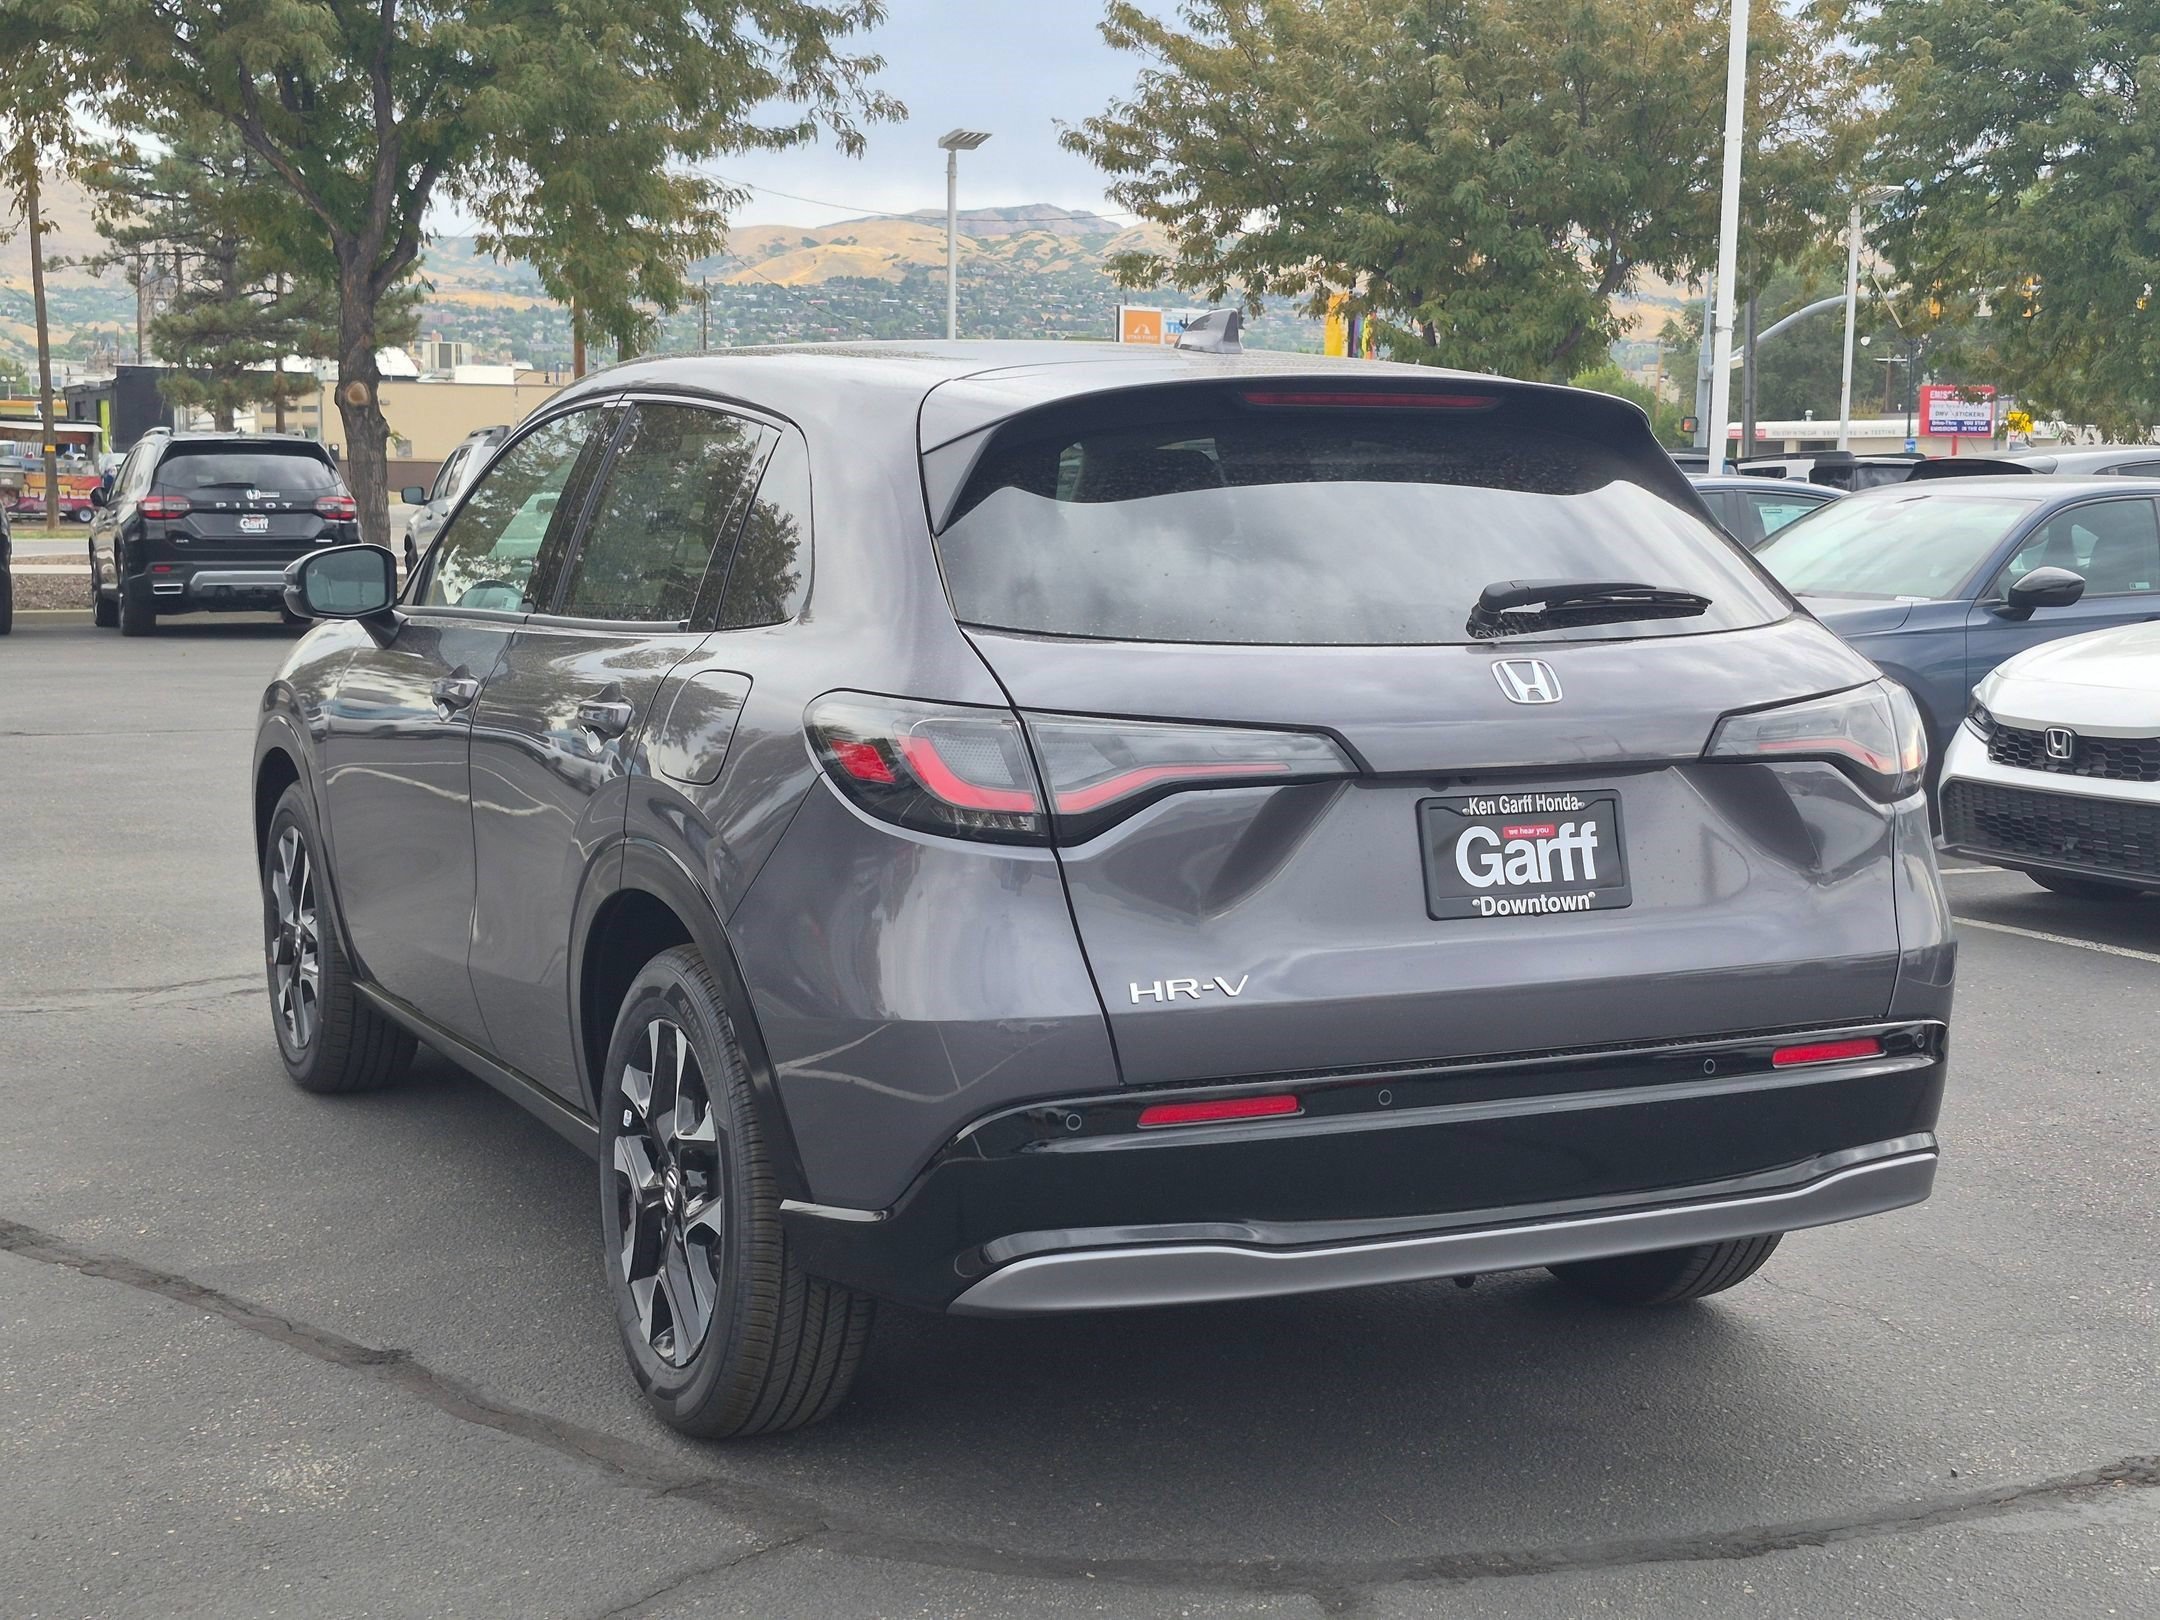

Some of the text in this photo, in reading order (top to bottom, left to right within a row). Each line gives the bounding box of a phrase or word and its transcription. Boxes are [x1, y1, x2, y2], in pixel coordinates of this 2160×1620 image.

[1468, 793, 1579, 816] Ken Garff Honda
[1536, 827, 1549, 836] you
[1455, 821, 1598, 888] Garff
[1480, 894, 1590, 917] Downtown
[1129, 974, 1249, 1004] HR-V
